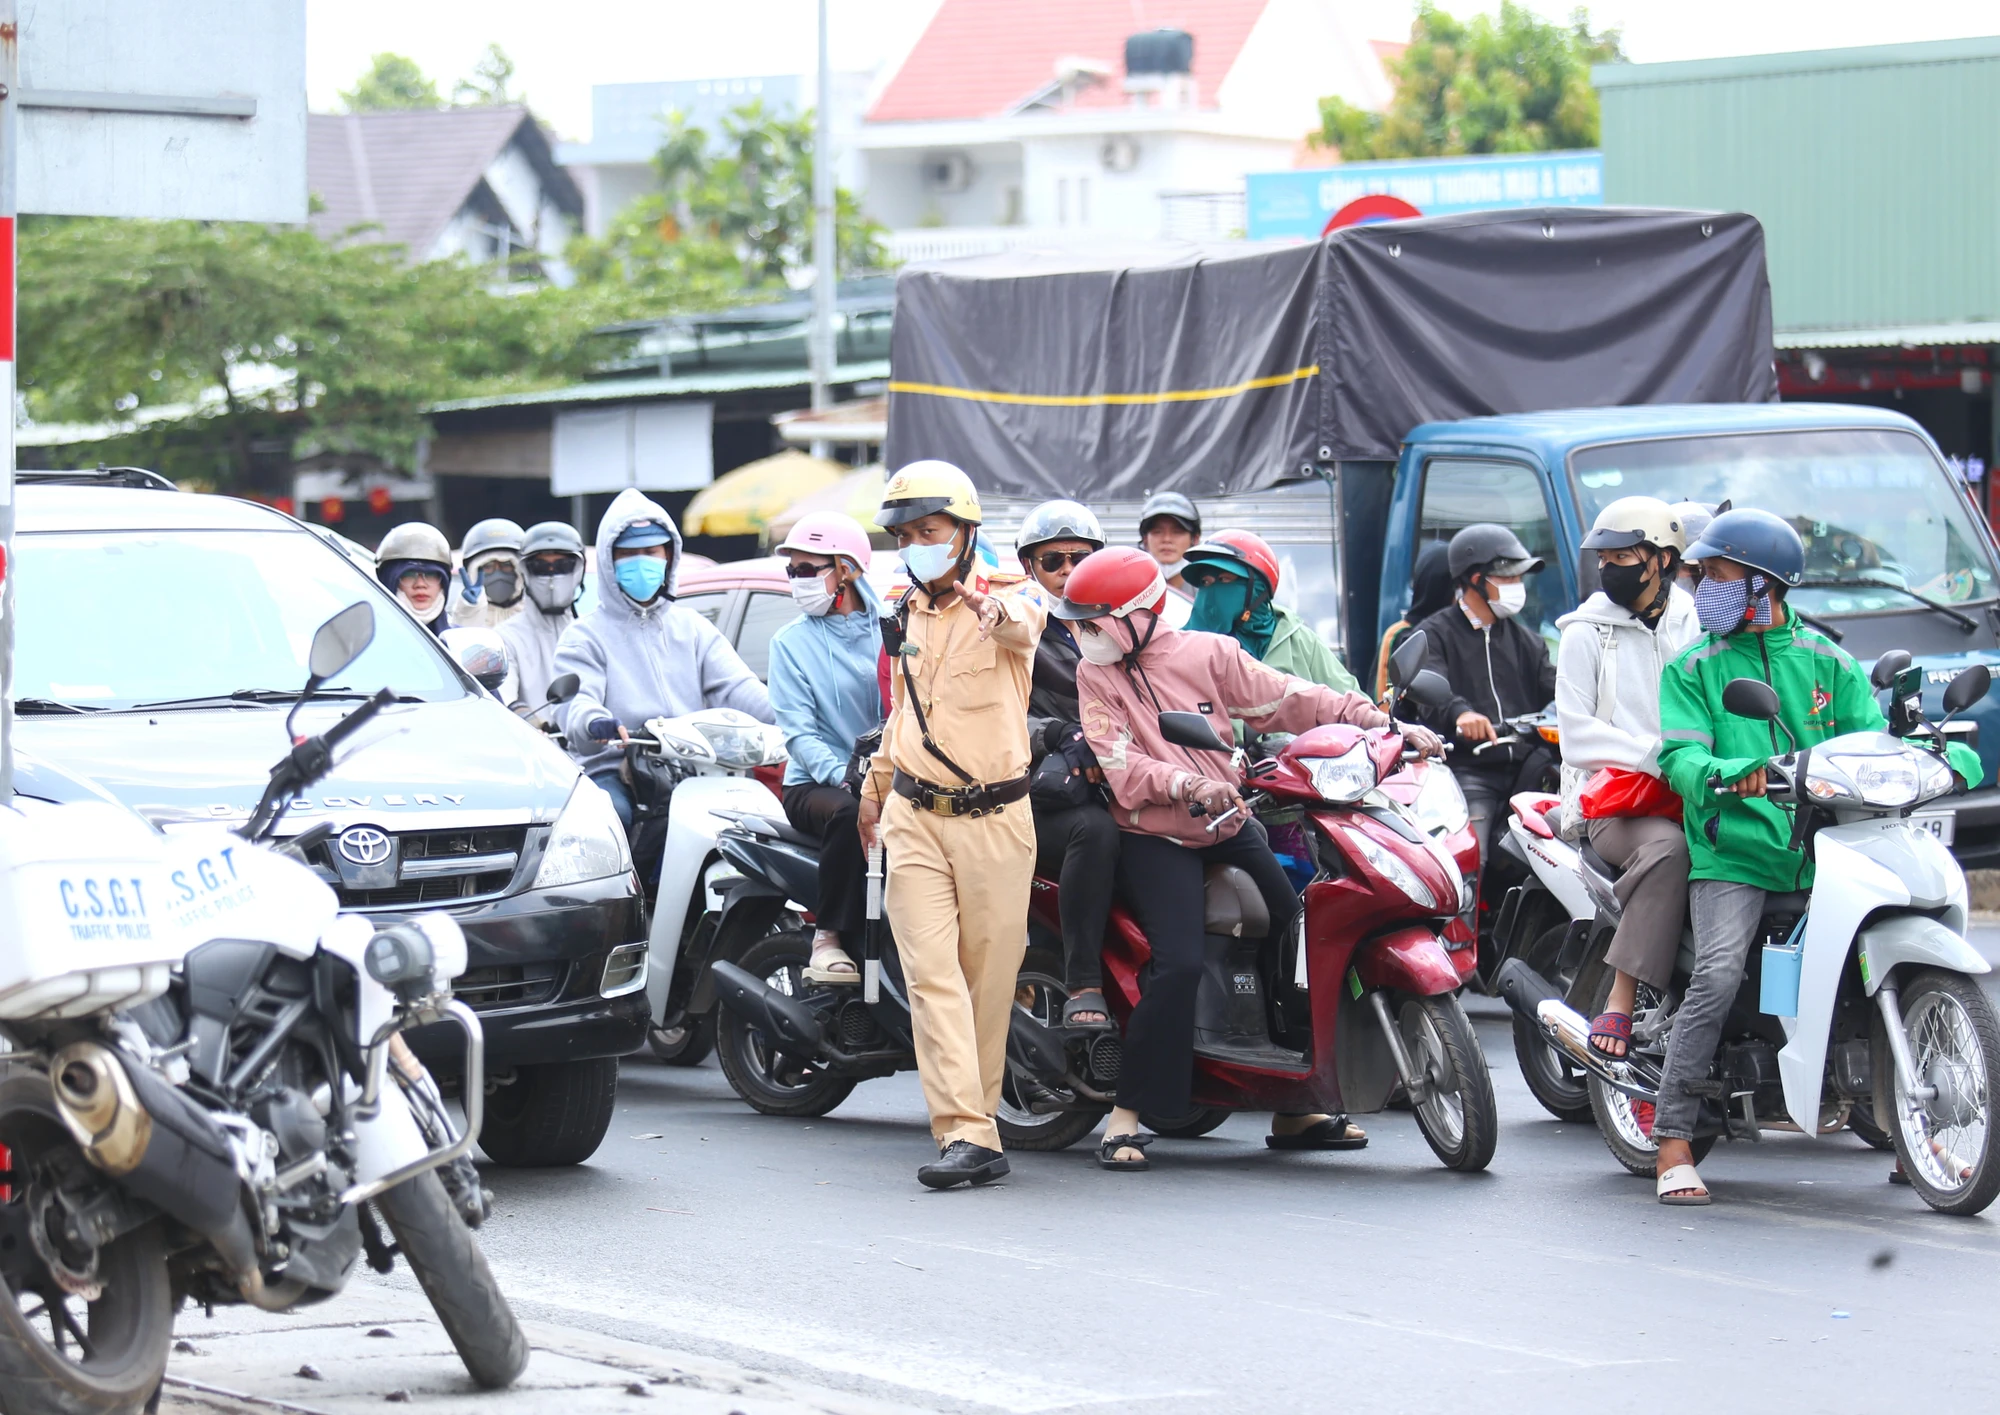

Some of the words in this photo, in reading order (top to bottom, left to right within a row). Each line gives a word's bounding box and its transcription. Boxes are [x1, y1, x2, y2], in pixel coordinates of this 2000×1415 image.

[1527, 843, 1558, 868] VISION
[165, 846, 238, 911] .S.G.T
[59, 878, 148, 919] C.S.G.T
[69, 923, 113, 941] TRAFFIC
